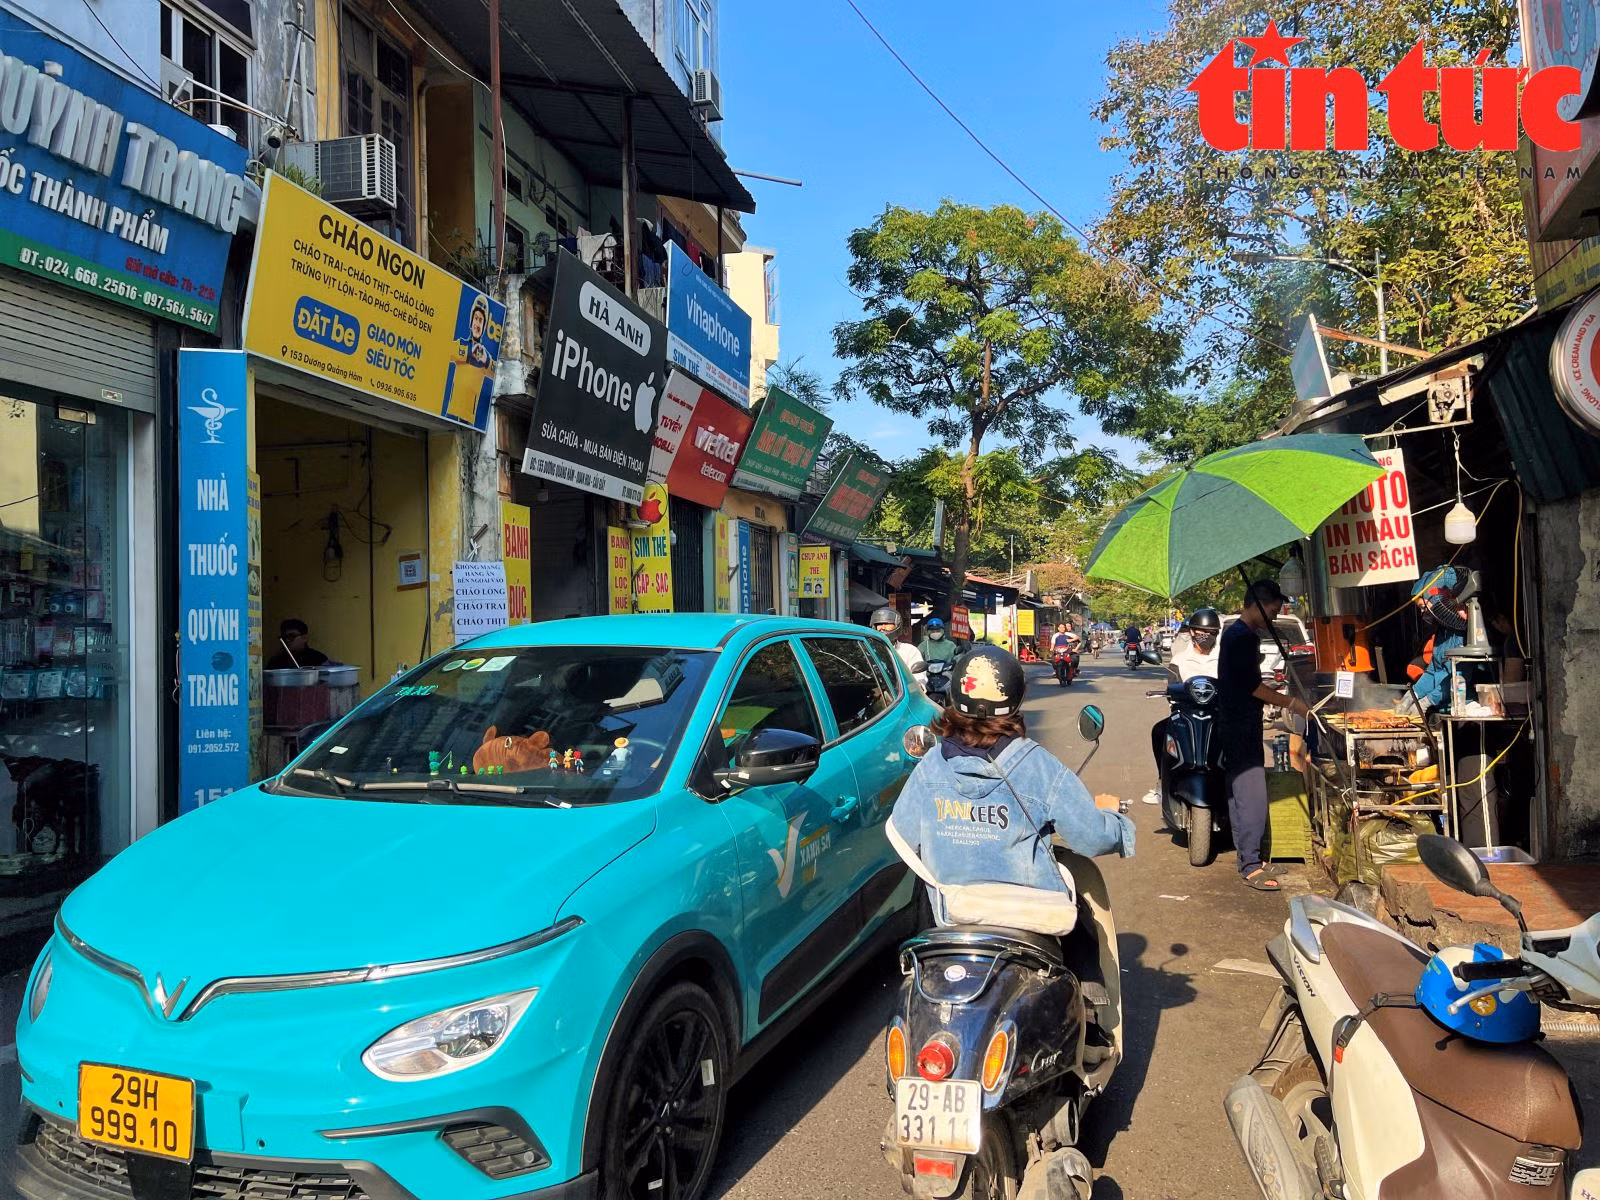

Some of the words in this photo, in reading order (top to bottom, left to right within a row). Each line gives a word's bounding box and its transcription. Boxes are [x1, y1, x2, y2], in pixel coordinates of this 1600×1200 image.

[0, 55, 124, 177] UỲNH
[121, 121, 244, 236] TRANG
[29, 170, 108, 231] THÀNH
[105, 208, 170, 255] PHẨM
[319, 214, 374, 261] CHÁO
[376, 245, 426, 290] NGON
[291, 258, 322, 281] TRỨNG
[323, 273, 337, 289] VỊT
[418, 321, 433, 334] ĐEN
[293, 239, 321, 260] CHÁO
[415, 301, 435, 318] LÒNG
[297, 306, 331, 340] ĐẶT
[331, 314, 356, 348] be
[367, 323, 396, 349] GIAO
[396, 336, 422, 360] MÓN
[588, 296, 610, 327] HÀ
[614, 316, 644, 349] ANH
[686, 292, 740, 358] vinaphone
[289, 349, 303, 362] 153
[365, 348, 392, 371] SIÊU
[393, 357, 416, 381] TỐC
[551, 328, 632, 412] iPhone
[541, 421, 557, 442] SỬA
[558, 429, 579, 449] CHỮA
[583, 439, 598, 457] MUA
[599, 444, 613, 462] BÁN
[694, 425, 740, 466] viettel
[197, 473, 229, 511] NHÀ
[700, 461, 727, 483] telecom
[634, 537, 651, 558] SIM
[652, 529, 668, 557] THẺ
[1325, 522, 1351, 548] IN
[1355, 513, 1411, 545] MÀU
[188, 533, 238, 576] THUỐC
[1328, 549, 1364, 576] BÁN
[1367, 545, 1416, 571] SÁCH
[187, 602, 239, 644] QUỲNH
[485, 603, 506, 611] TRAI
[187, 674, 239, 707] TRANG
[196, 729, 215, 739] Liên
[935, 796, 1010, 831] YANKEES
[110, 1072, 159, 1112] 29H
[907, 1082, 966, 1114] 29-AB
[90, 1105, 178, 1152] 999.10
[900, 1114, 970, 1147] 331.11
